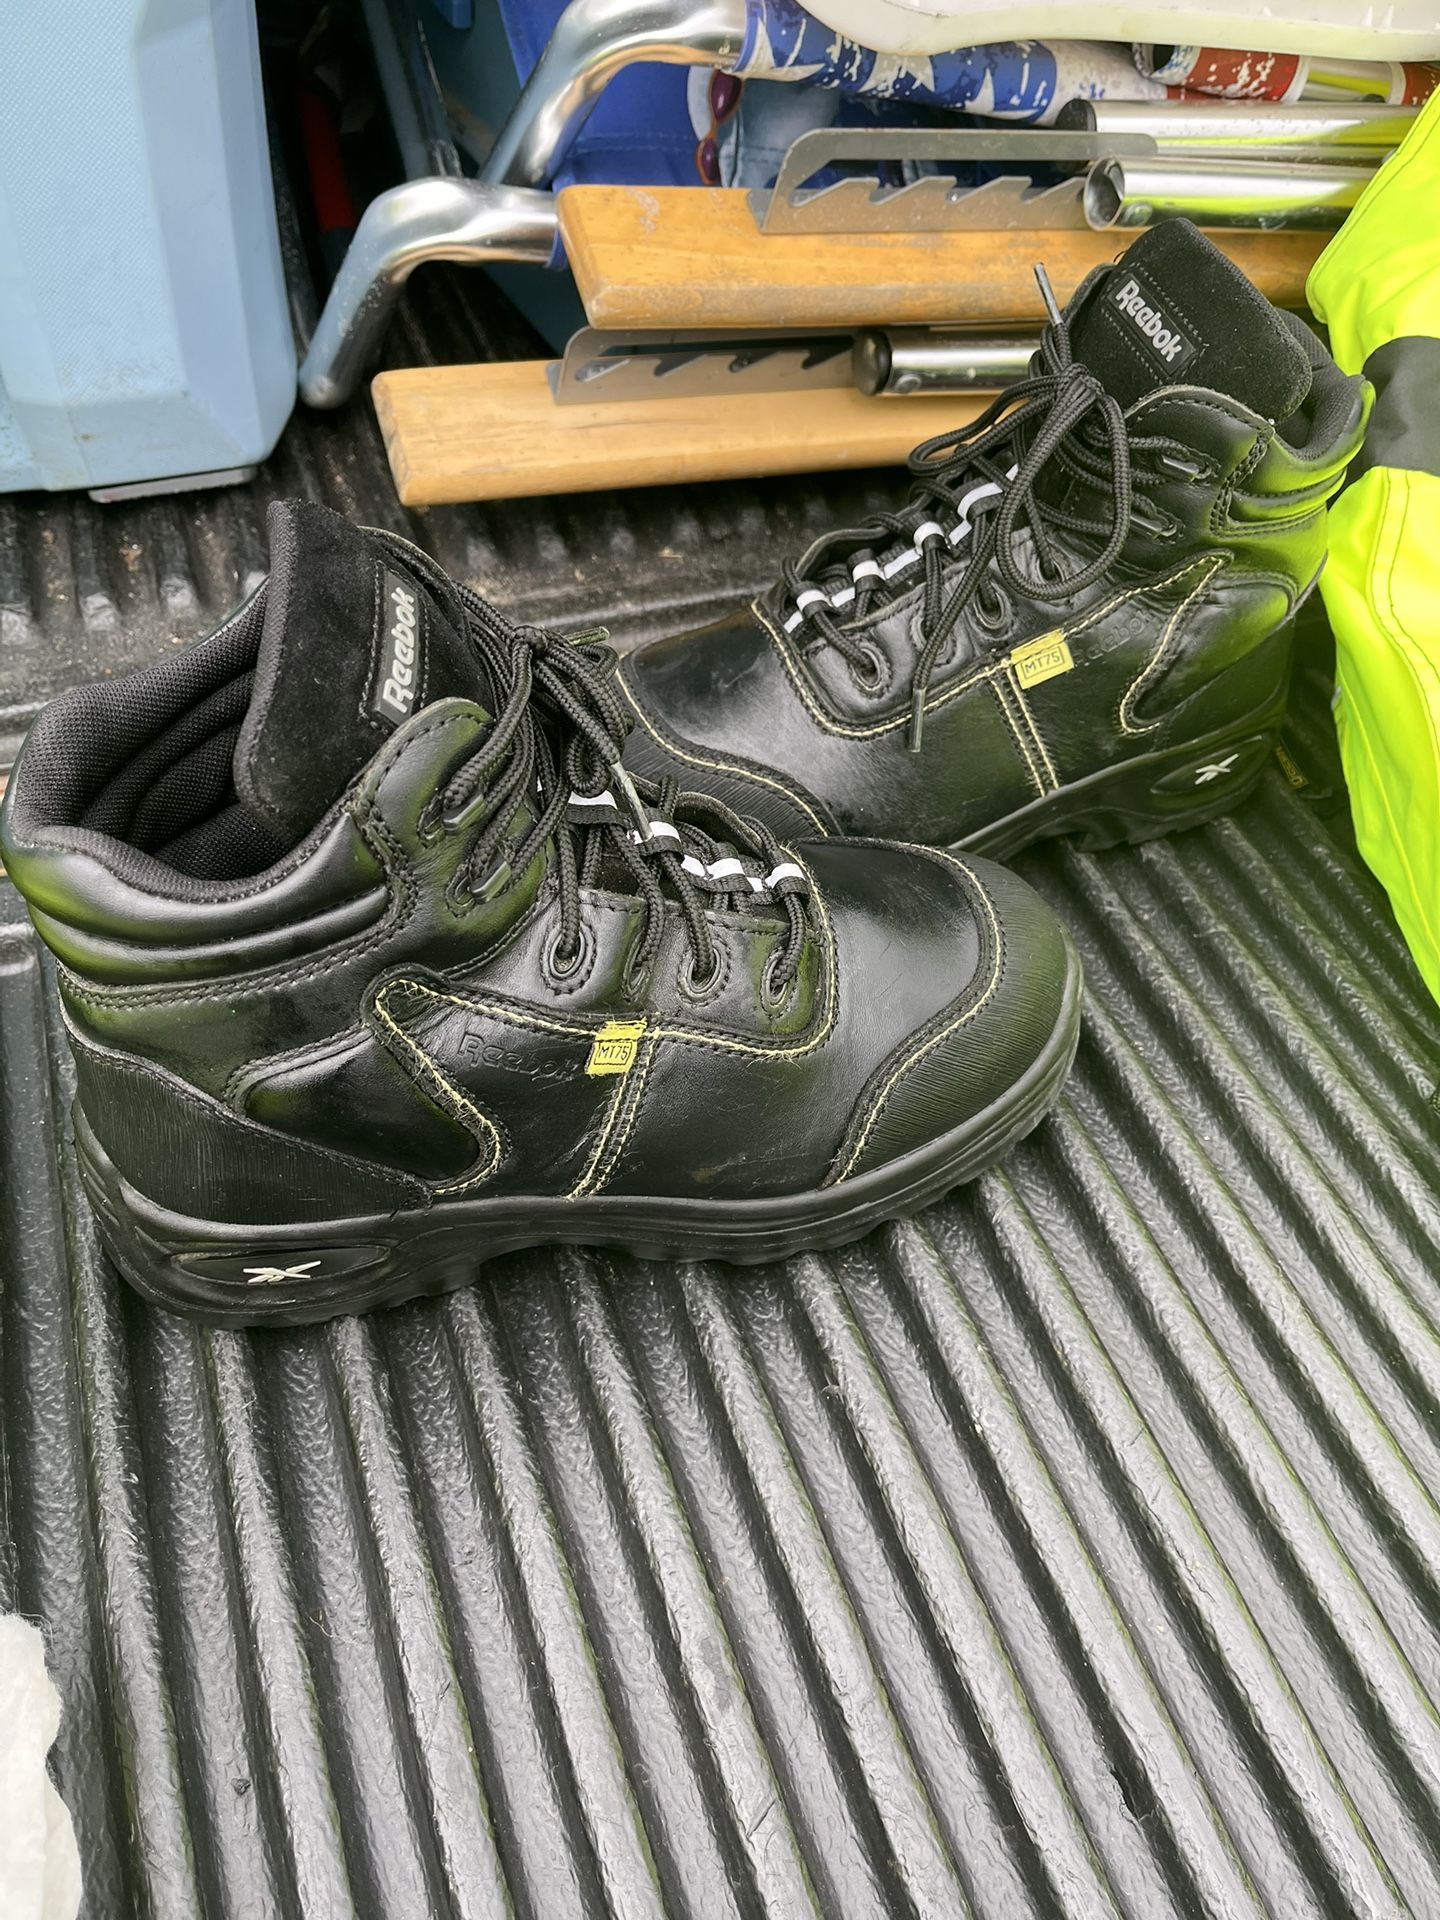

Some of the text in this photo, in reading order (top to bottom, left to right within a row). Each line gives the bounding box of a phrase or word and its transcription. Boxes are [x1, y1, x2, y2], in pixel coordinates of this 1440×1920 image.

[1115, 280, 1182, 362] Reebok
[383, 587, 416, 714] Reebok
[1024, 650, 1061, 674] MT75
[457, 1031, 580, 1080] Reebok
[599, 1045, 630, 1060] MT75
